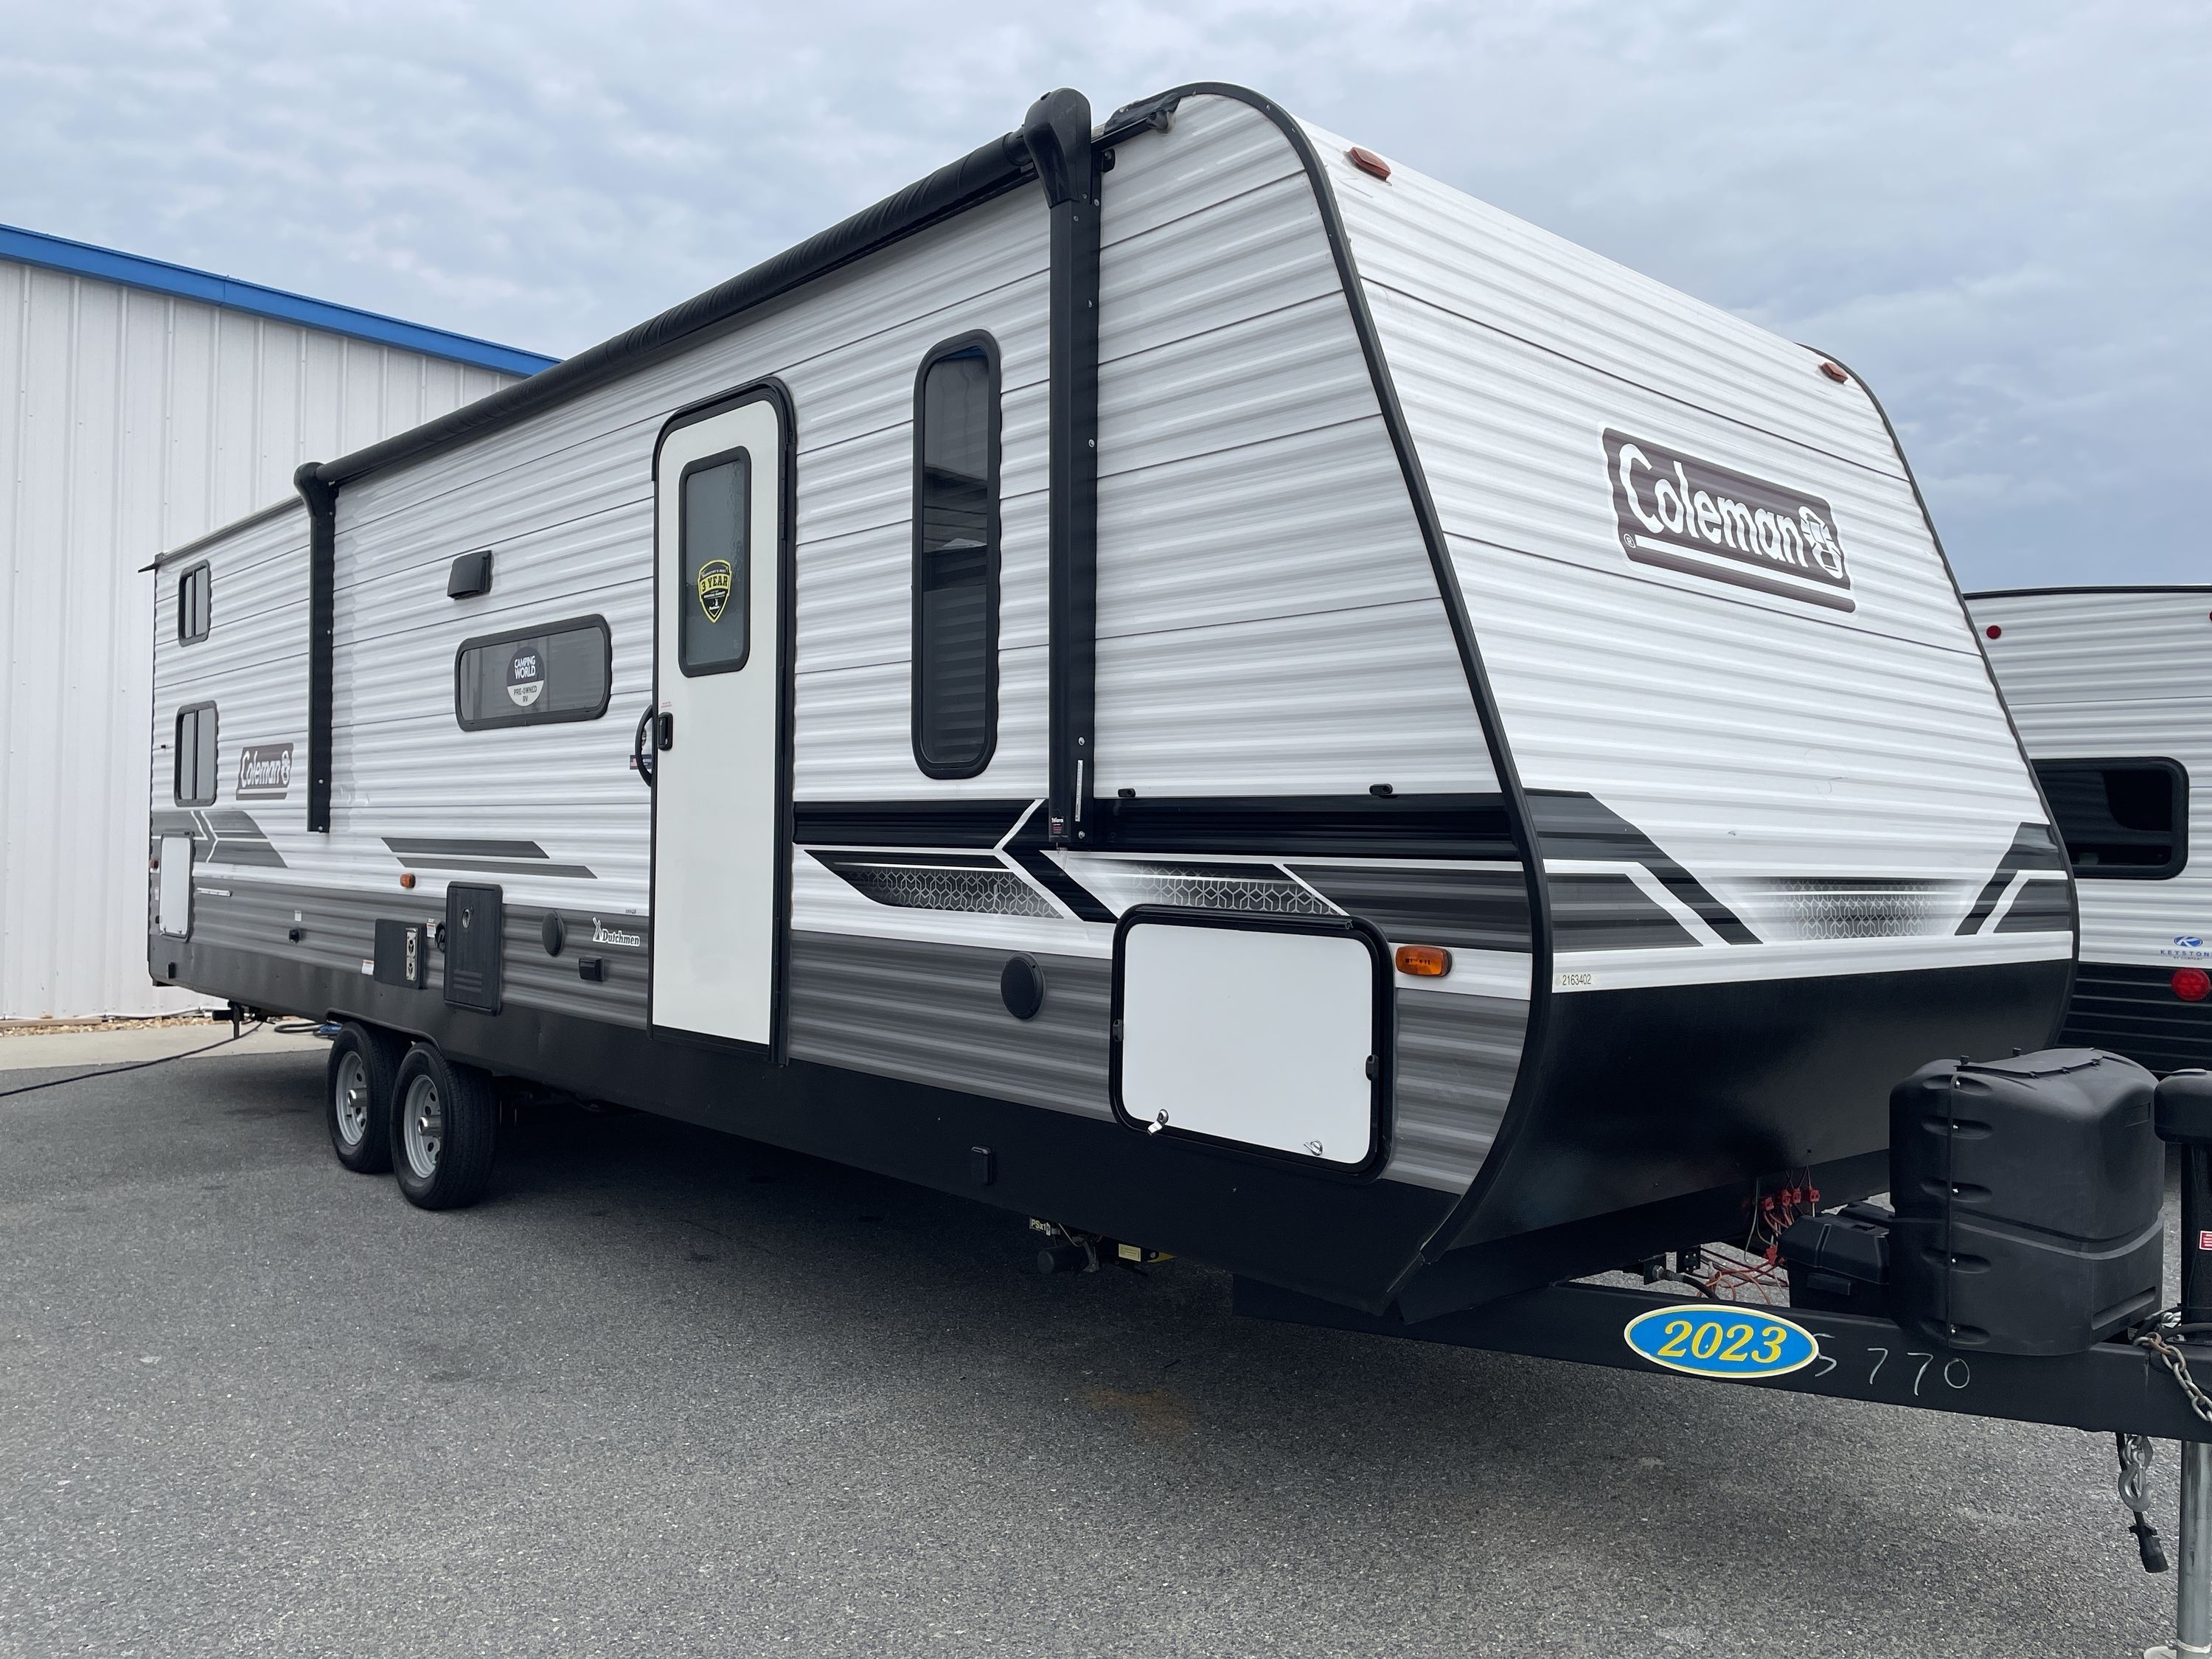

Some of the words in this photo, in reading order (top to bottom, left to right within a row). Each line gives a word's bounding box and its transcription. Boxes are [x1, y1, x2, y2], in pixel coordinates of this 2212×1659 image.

[1618, 443, 1809, 568] Coleman
[701, 581, 706, 592] 3
[708, 575, 728, 588] YEAR
[514, 655, 536, 668] CAMPING
[514, 665, 536, 679] WORLD
[513, 685, 538, 696] PRE-OWNED
[240, 750, 282, 787] Coleman
[602, 928, 640, 946] Dutchmen
[2160, 949, 2212, 957] KEYSTON
[1562, 973, 1592, 986] 2163402
[1657, 1321, 1787, 1363] 2023
